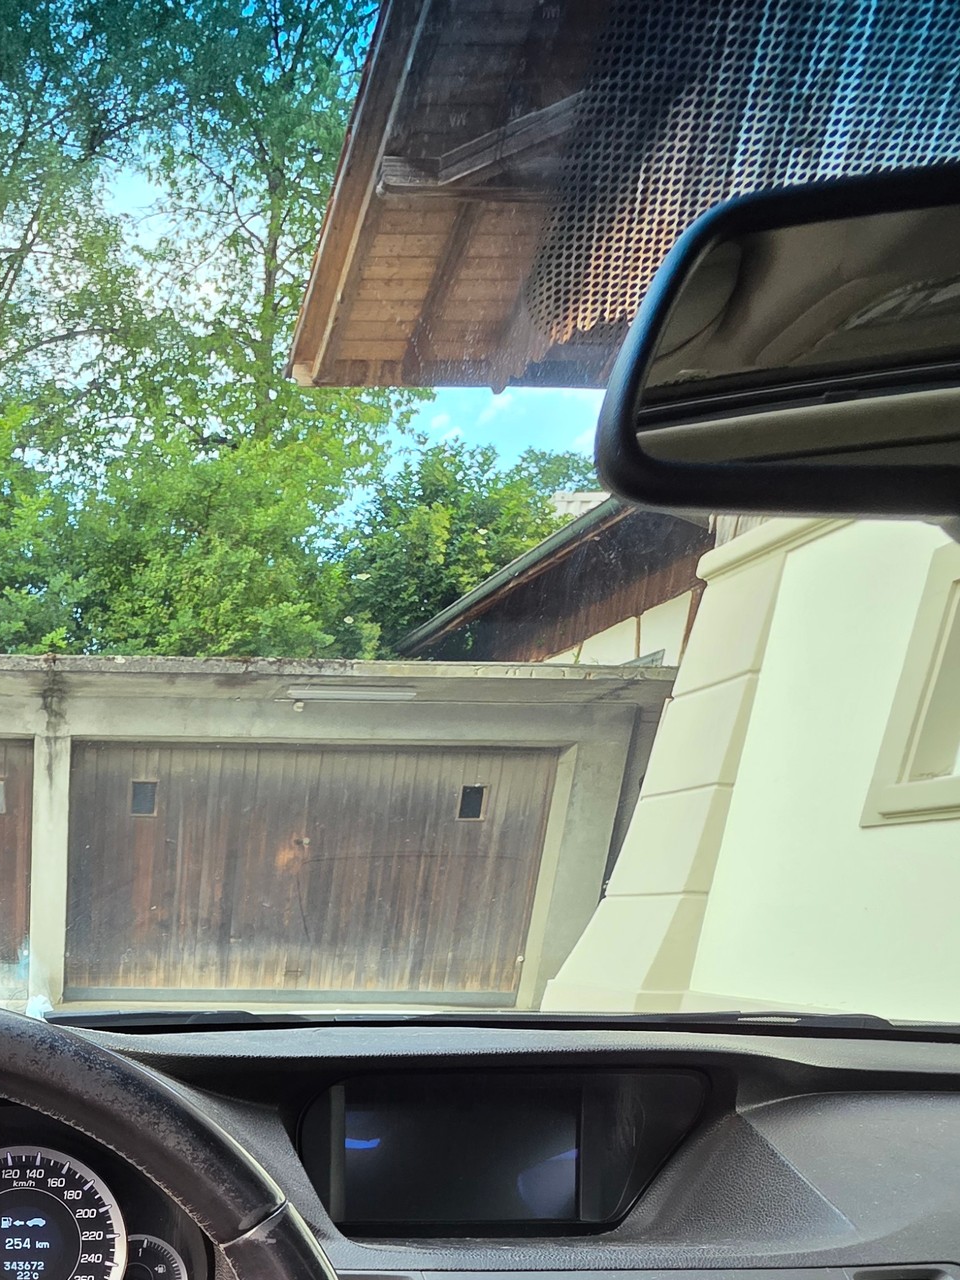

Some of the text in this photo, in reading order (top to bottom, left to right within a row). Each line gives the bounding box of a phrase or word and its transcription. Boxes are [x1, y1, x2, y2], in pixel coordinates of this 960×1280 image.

[1, 1169, 20, 1179] 120
[26, 1169, 45, 1178] 140
[47, 1178, 66, 1188] 160
[63, 1190, 82, 1200] 180
[75, 1209, 97, 1219] 200
[81, 1231, 103, 1241] 220
[5, 1238, 50, 1250] 254 km
[80, 1253, 102, 1263] 240
[3, 1261, 45, 1270] 343672
